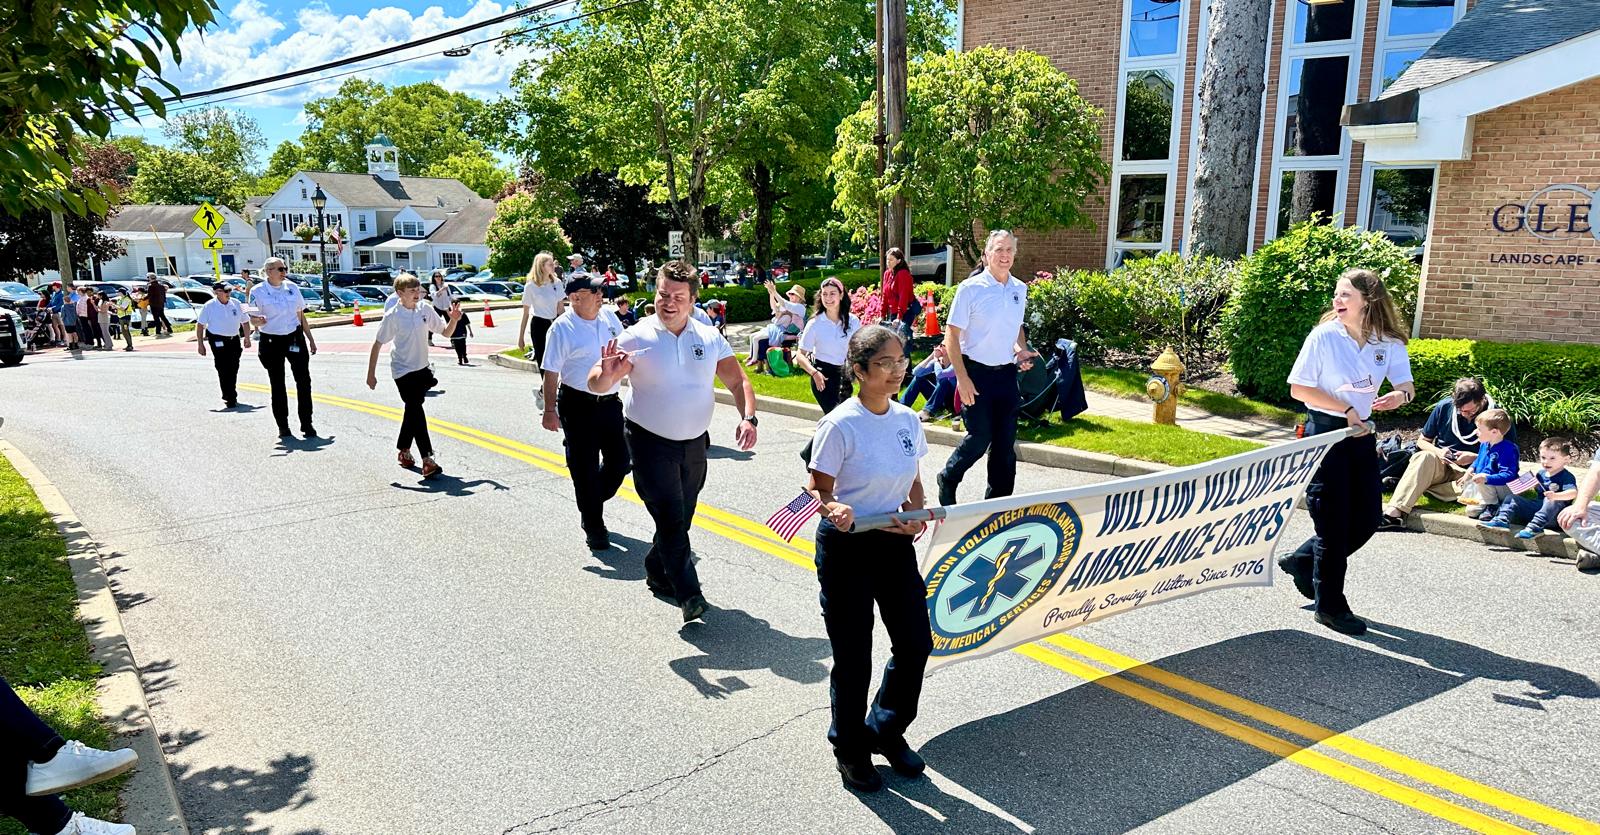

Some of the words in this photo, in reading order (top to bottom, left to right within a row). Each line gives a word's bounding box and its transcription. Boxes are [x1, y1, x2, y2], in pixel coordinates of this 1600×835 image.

[672, 245, 685, 255] 20
[1490, 253, 1584, 265] LANDSCAPE
[1096, 478, 1197, 537] WILTON
[1196, 444, 1328, 515] VOLUNTEER
[957, 507, 1025, 555] VOLUNTEER
[1027, 503, 1077, 539] AMBULANCE
[1053, 536, 1076, 570] CORPS
[1057, 518, 1226, 596] AMBULANCE
[1211, 497, 1293, 555] CORPS
[949, 625, 997, 649] MEDICAL
[999, 578, 1052, 625] SERVICES
[1043, 598, 1096, 628] Proudly
[1099, 588, 1147, 609] Serving
[1151, 573, 1192, 596] Wilton
[1196, 567, 1228, 585] Since
[1230, 557, 1265, 578] 1976
